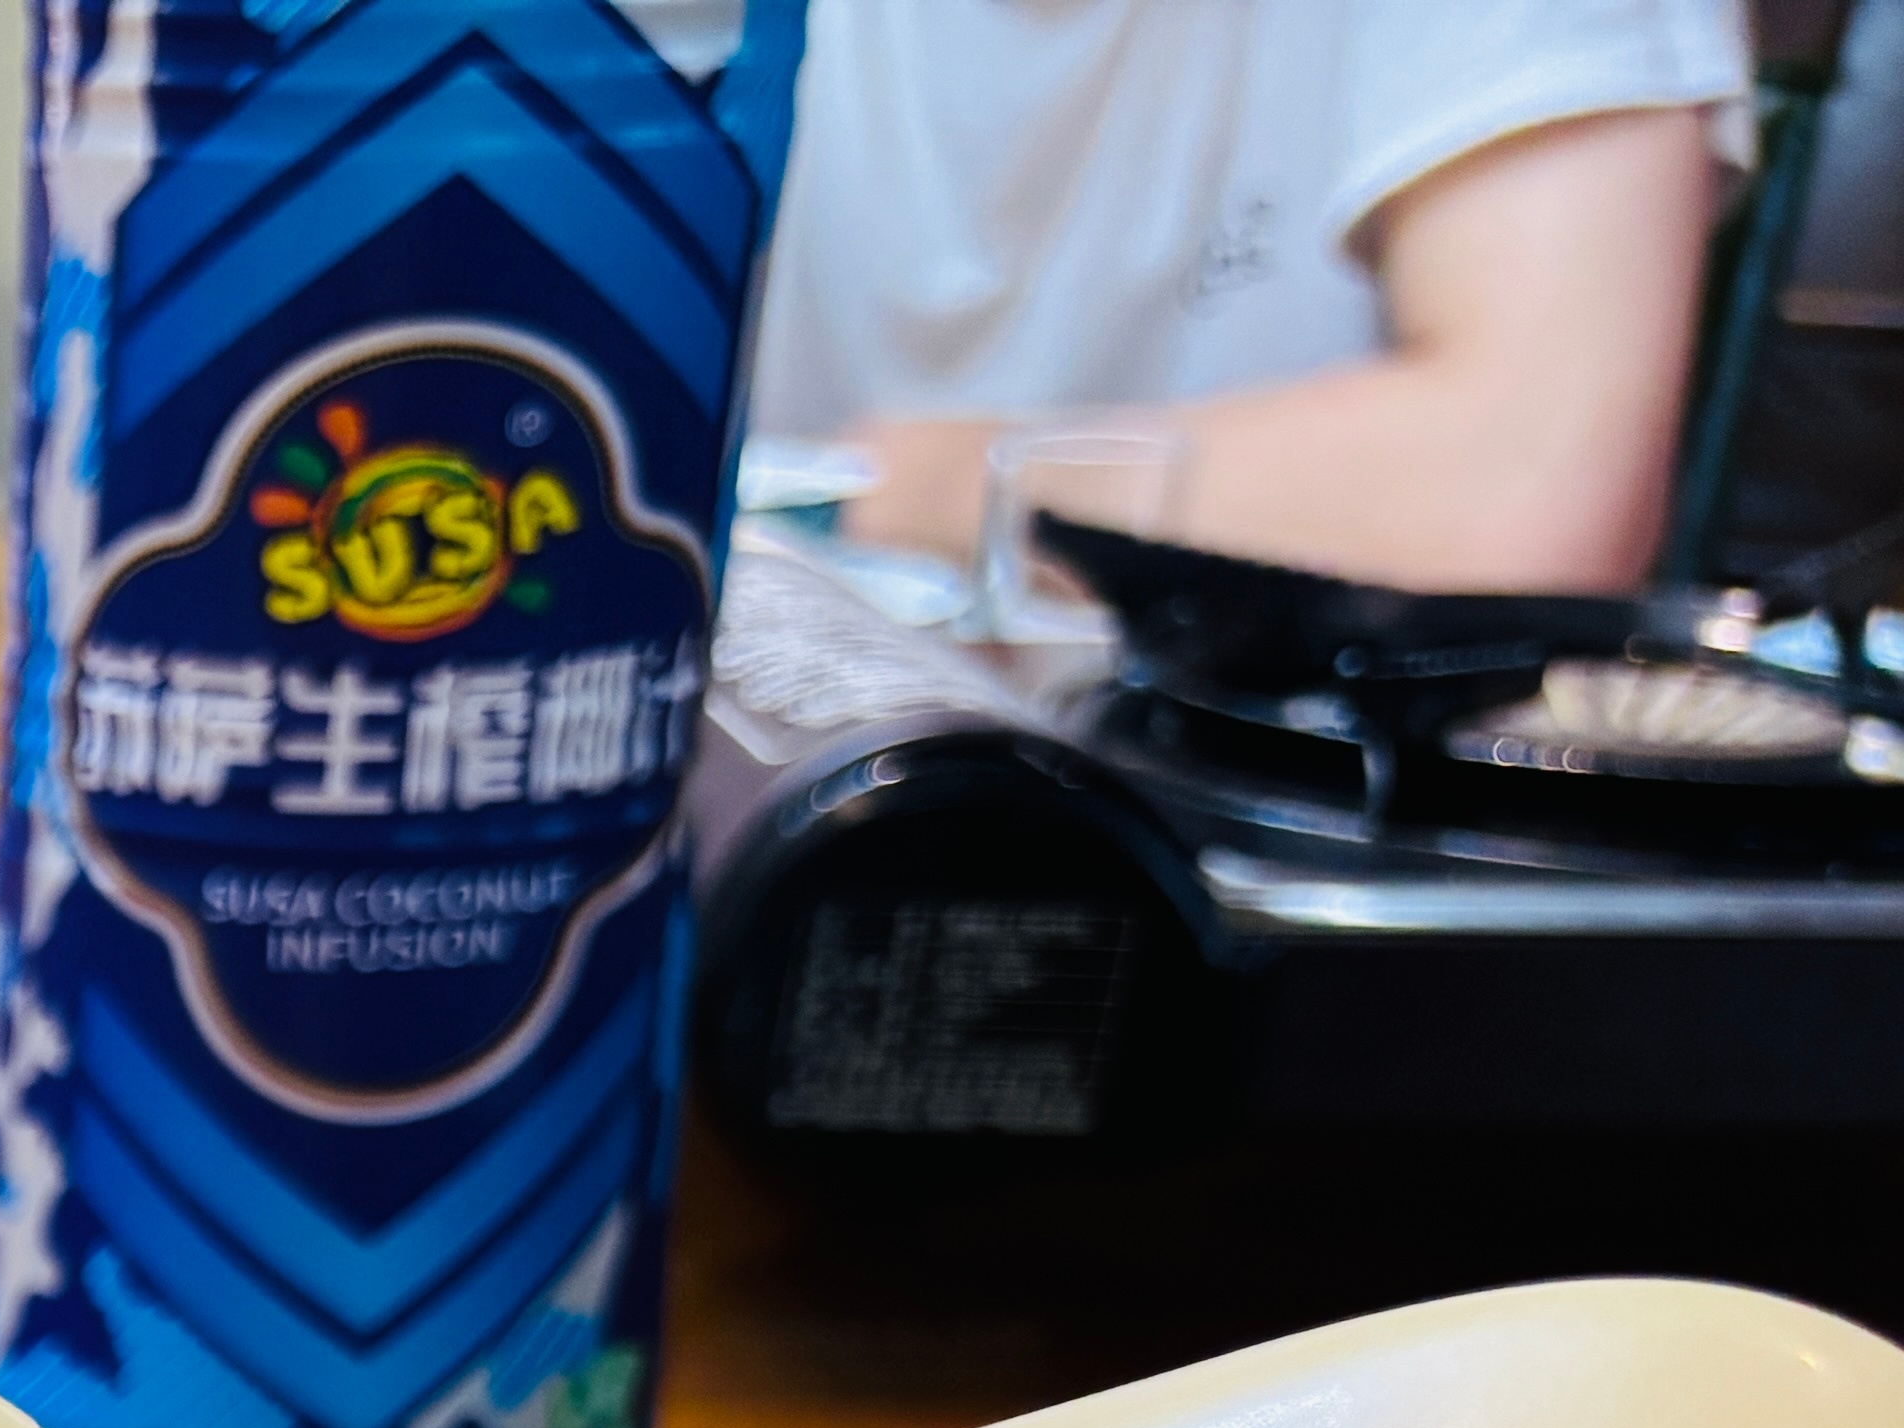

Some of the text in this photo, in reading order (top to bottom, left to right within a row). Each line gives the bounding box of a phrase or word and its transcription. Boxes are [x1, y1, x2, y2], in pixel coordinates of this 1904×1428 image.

[259, 470, 581, 624] SUSA
[202, 863, 576, 926] SUSA COCONUT
[266, 920, 510, 973] INFUSION
